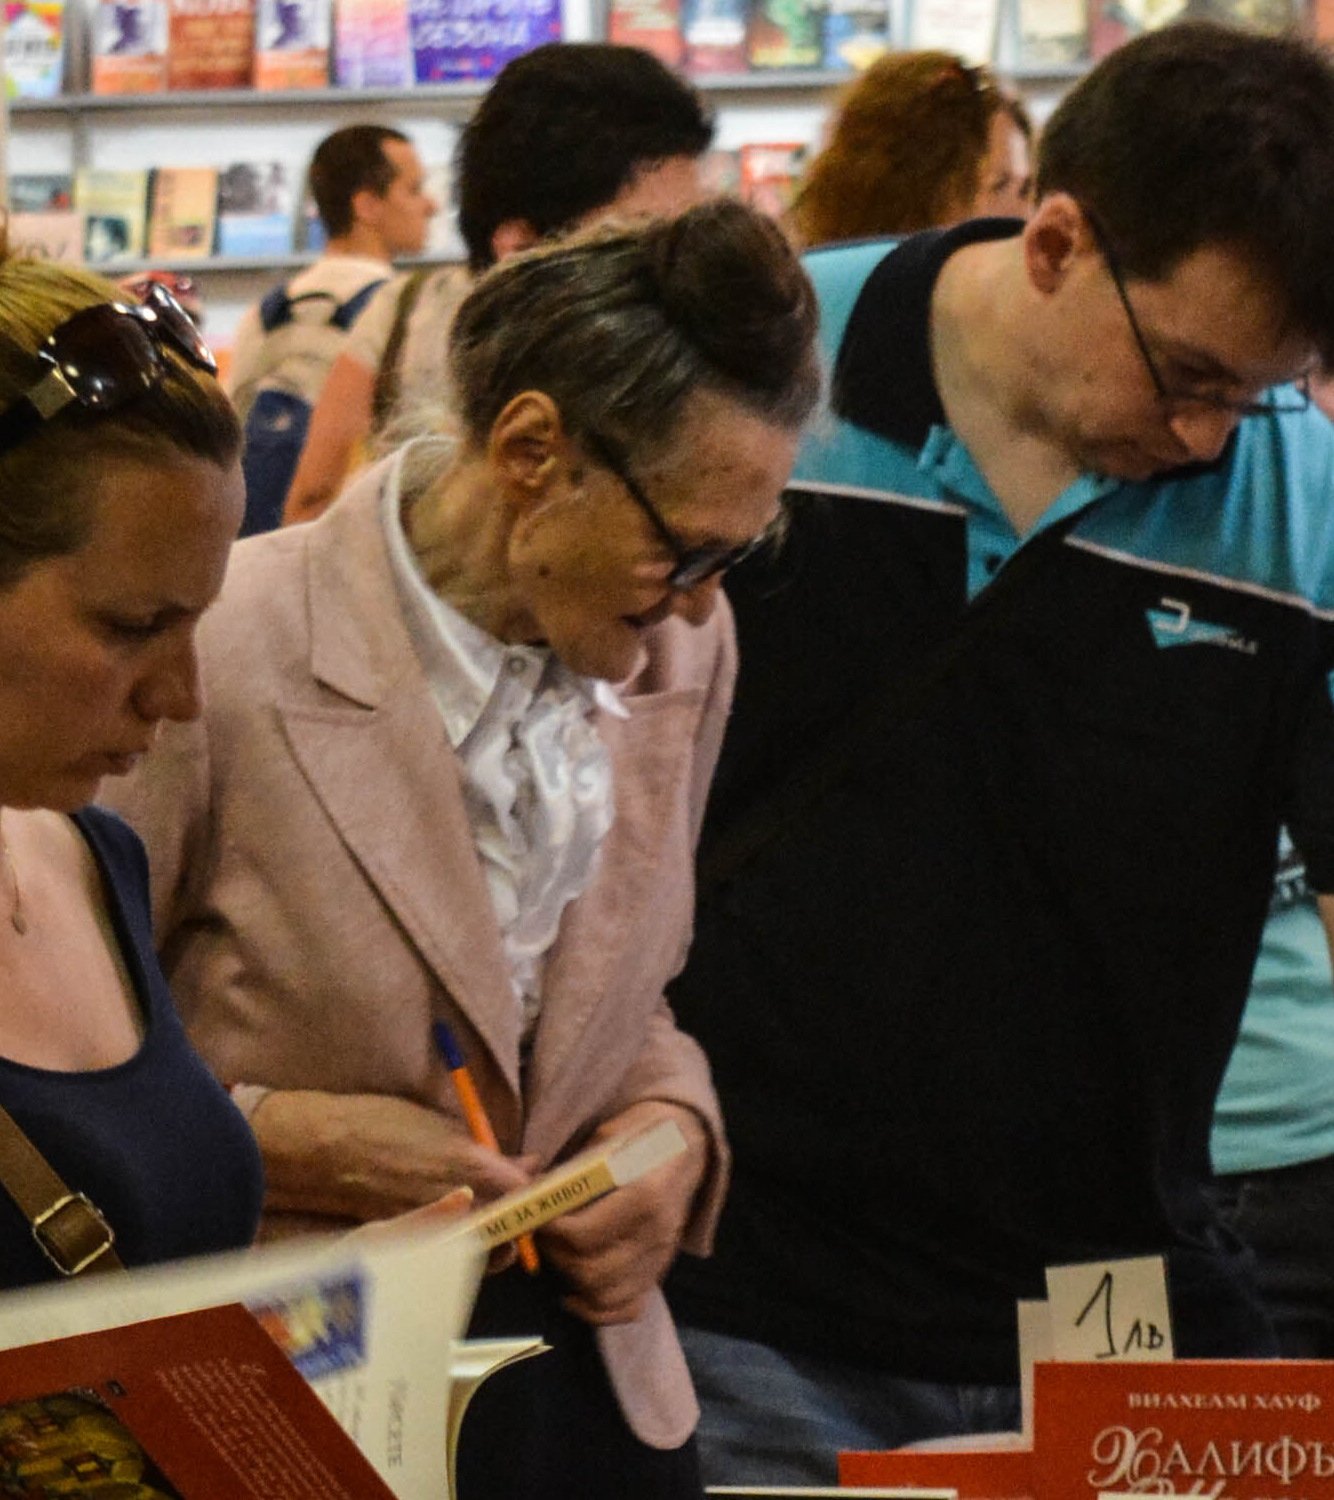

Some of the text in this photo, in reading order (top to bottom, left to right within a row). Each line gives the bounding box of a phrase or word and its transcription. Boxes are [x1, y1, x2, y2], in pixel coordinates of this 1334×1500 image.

[538, 1176, 592, 1212] ЖИВОТ
[1128, 1392, 1322, 1413] ВИЛХЕЛМ ХАУФ
